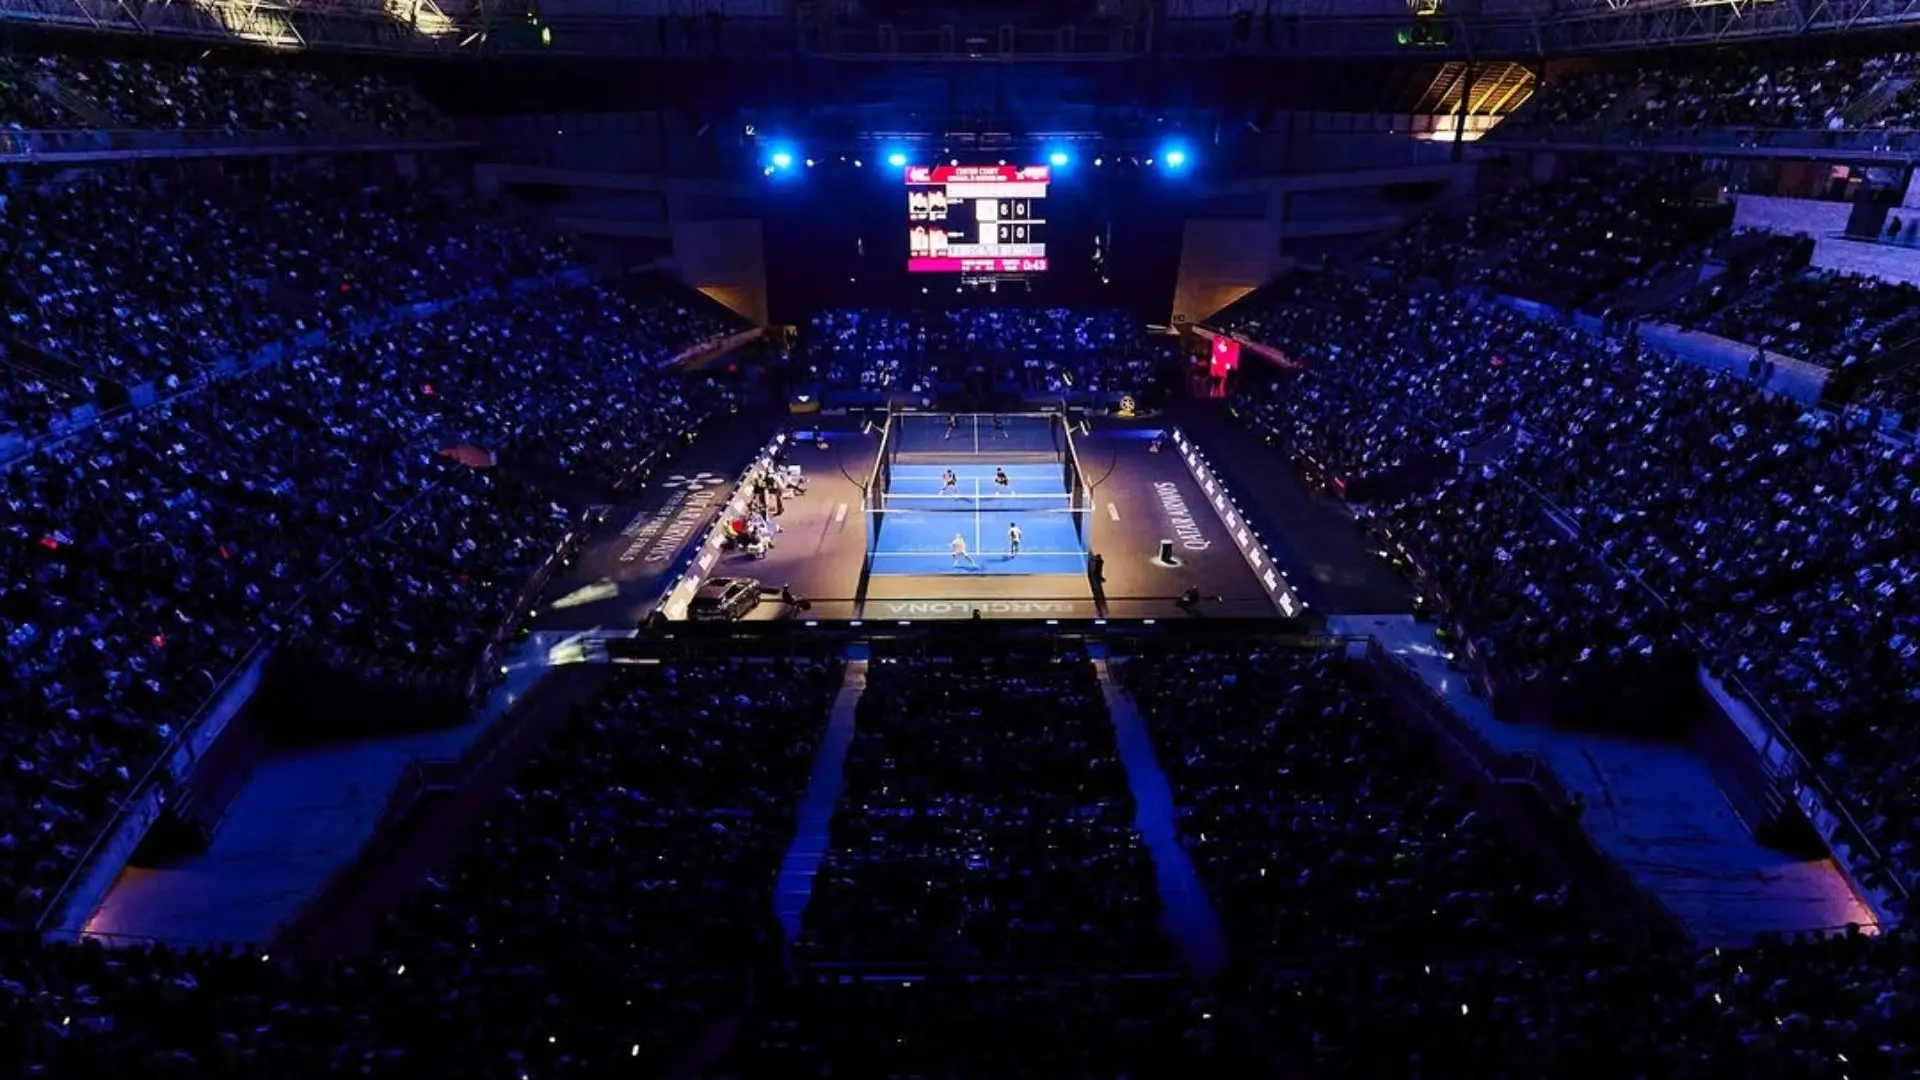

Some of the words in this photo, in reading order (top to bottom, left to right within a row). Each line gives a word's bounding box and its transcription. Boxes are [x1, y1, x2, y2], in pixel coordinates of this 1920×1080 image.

[1001, 204, 1008, 215] 6
[1017, 204, 1024, 215] 0
[1001, 227, 1008, 238] 3
[1017, 227, 1024, 238] 0
[1153, 482, 1191, 517] AIRWAYS
[1171, 515, 1212, 550] QATAR
[886, 602, 1076, 614] BARCELONA
